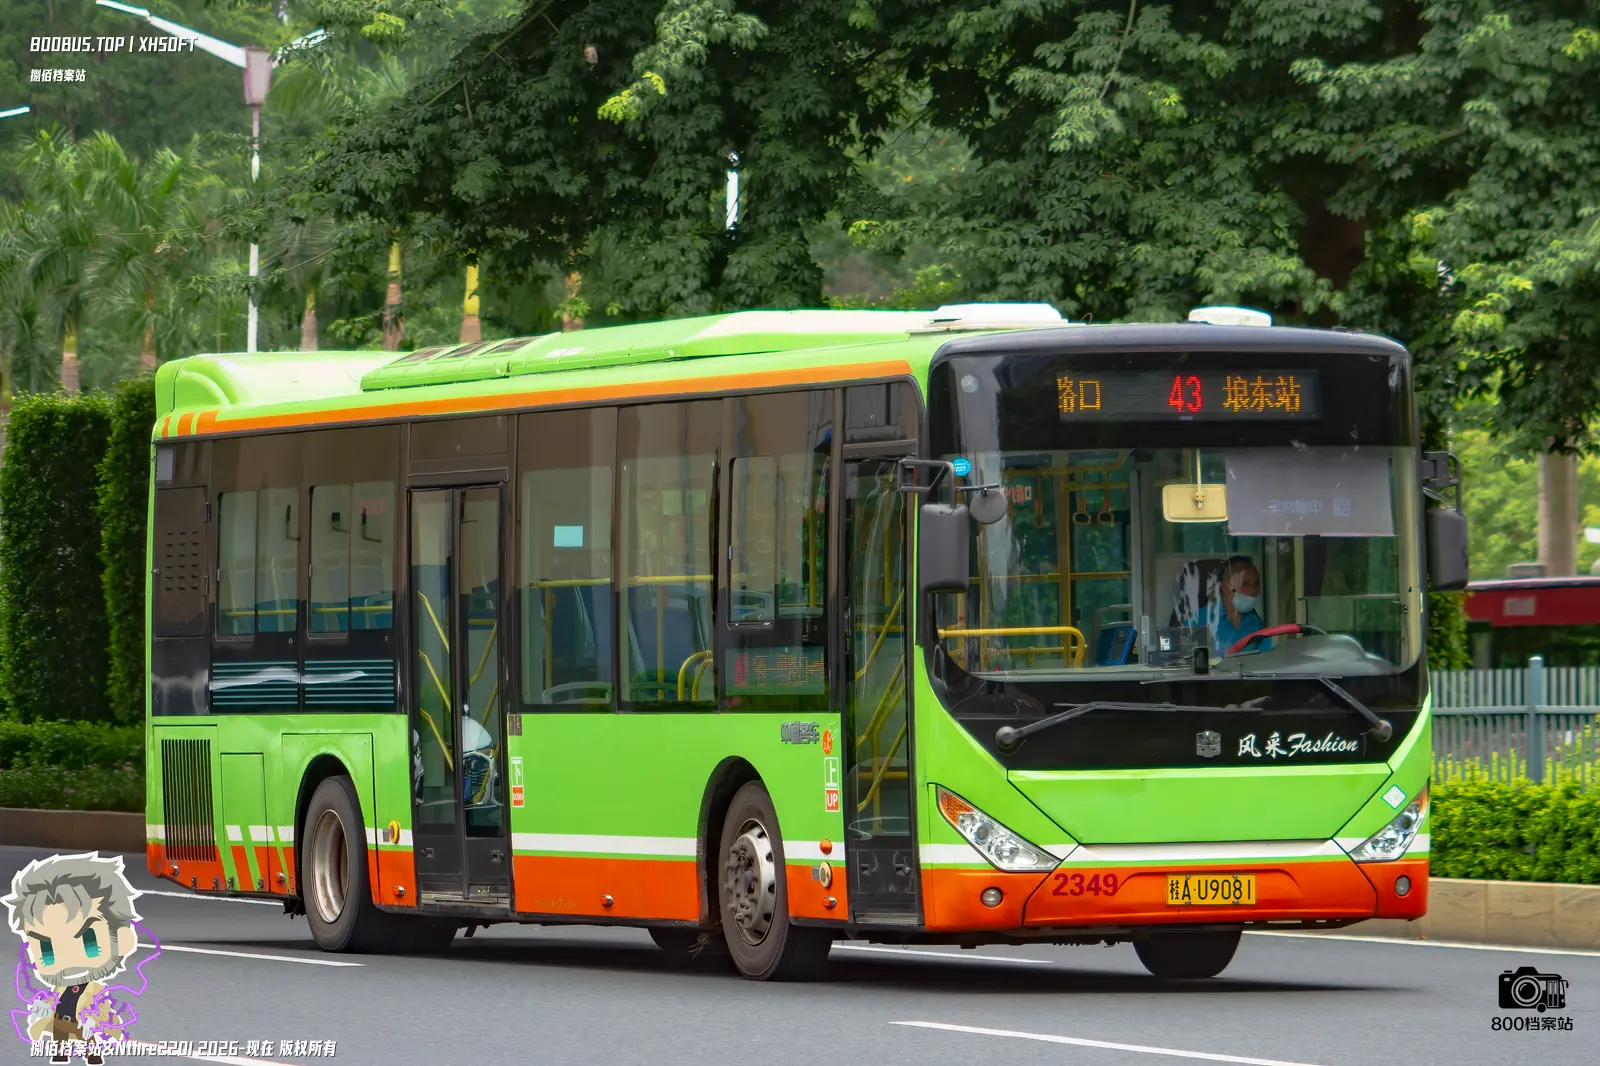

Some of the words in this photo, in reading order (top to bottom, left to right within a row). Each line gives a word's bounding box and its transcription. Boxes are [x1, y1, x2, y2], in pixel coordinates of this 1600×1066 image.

[1168, 375, 1203, 412] 43
[1223, 376, 1301, 412] 埌东站
[1238, 731, 1287, 759] 风采
[1287, 731, 1359, 758] Fashion
[511, 759, 523, 785] 下
[826, 759, 838, 788] 上
[826, 793, 838, 807] UP
[1052, 873, 1119, 897] 2349
